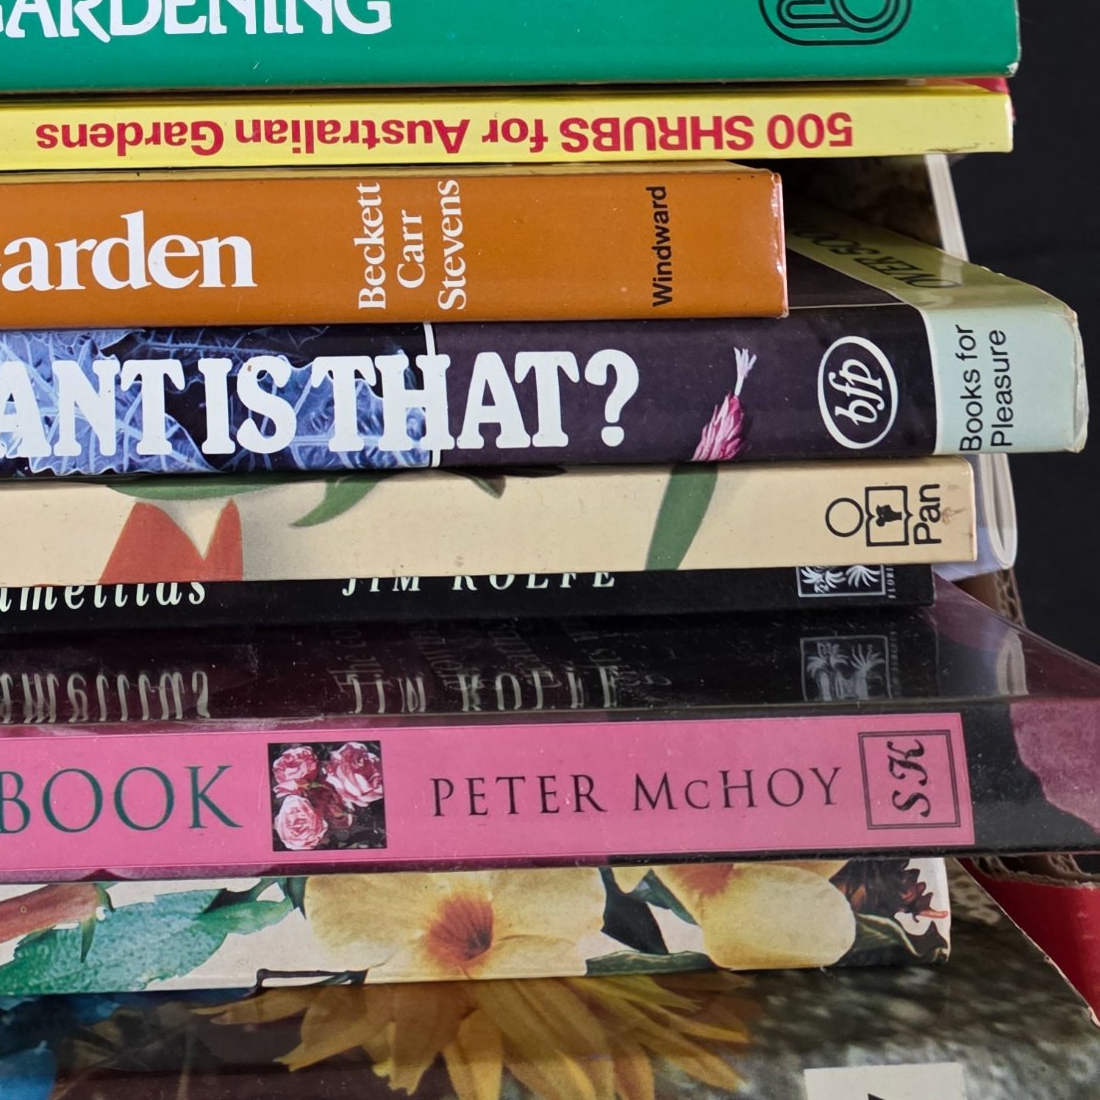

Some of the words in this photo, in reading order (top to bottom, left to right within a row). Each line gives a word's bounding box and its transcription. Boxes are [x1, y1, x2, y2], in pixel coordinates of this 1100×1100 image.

[36, 119, 224, 157] Gardens
[236, 117, 470, 156] Australian
[481, 117, 549, 154] for
[561, 114, 754, 154] SHRUBS
[767, 111, 854, 148] 500
[354, 182, 386, 311] Beckett
[397, 210, 425, 289] Carr
[437, 178, 467, 311] Stevens
[645, 184, 673, 307] Windward
[955, 324, 978, 363] for
[200, 355, 299, 455] IS
[311, 348, 641, 452] THAT?
[959, 370, 983, 451] Books
[989, 330, 1014, 447] Pleasure
[912, 483, 941, 545] Pan
[431, 772, 608, 818] PETER
